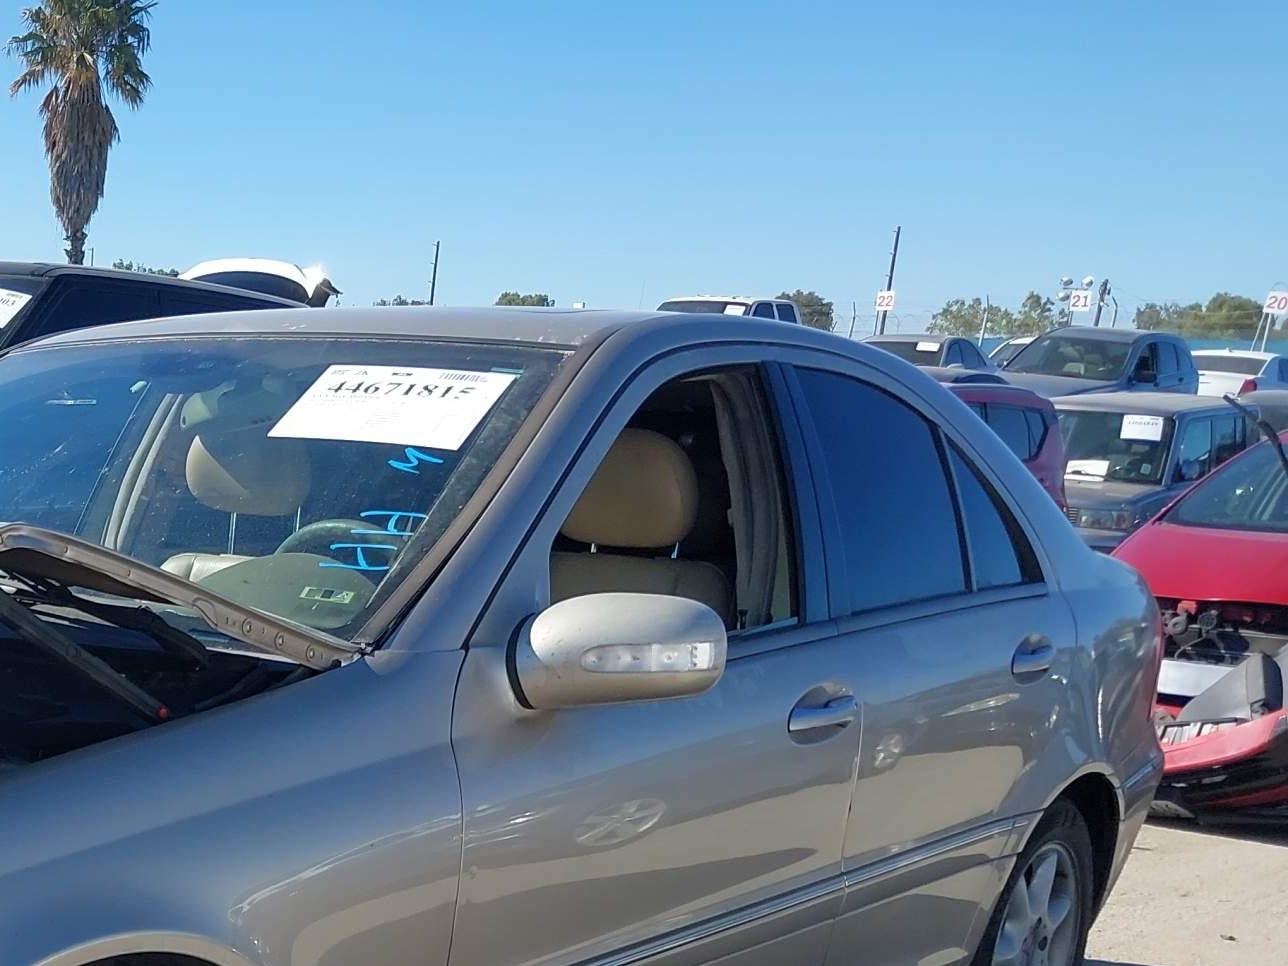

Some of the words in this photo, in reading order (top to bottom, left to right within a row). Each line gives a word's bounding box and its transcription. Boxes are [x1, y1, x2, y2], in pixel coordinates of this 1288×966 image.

[878, 295, 894, 307] 22
[1071, 294, 1089, 308] 21
[1266, 295, 1288, 310] 20
